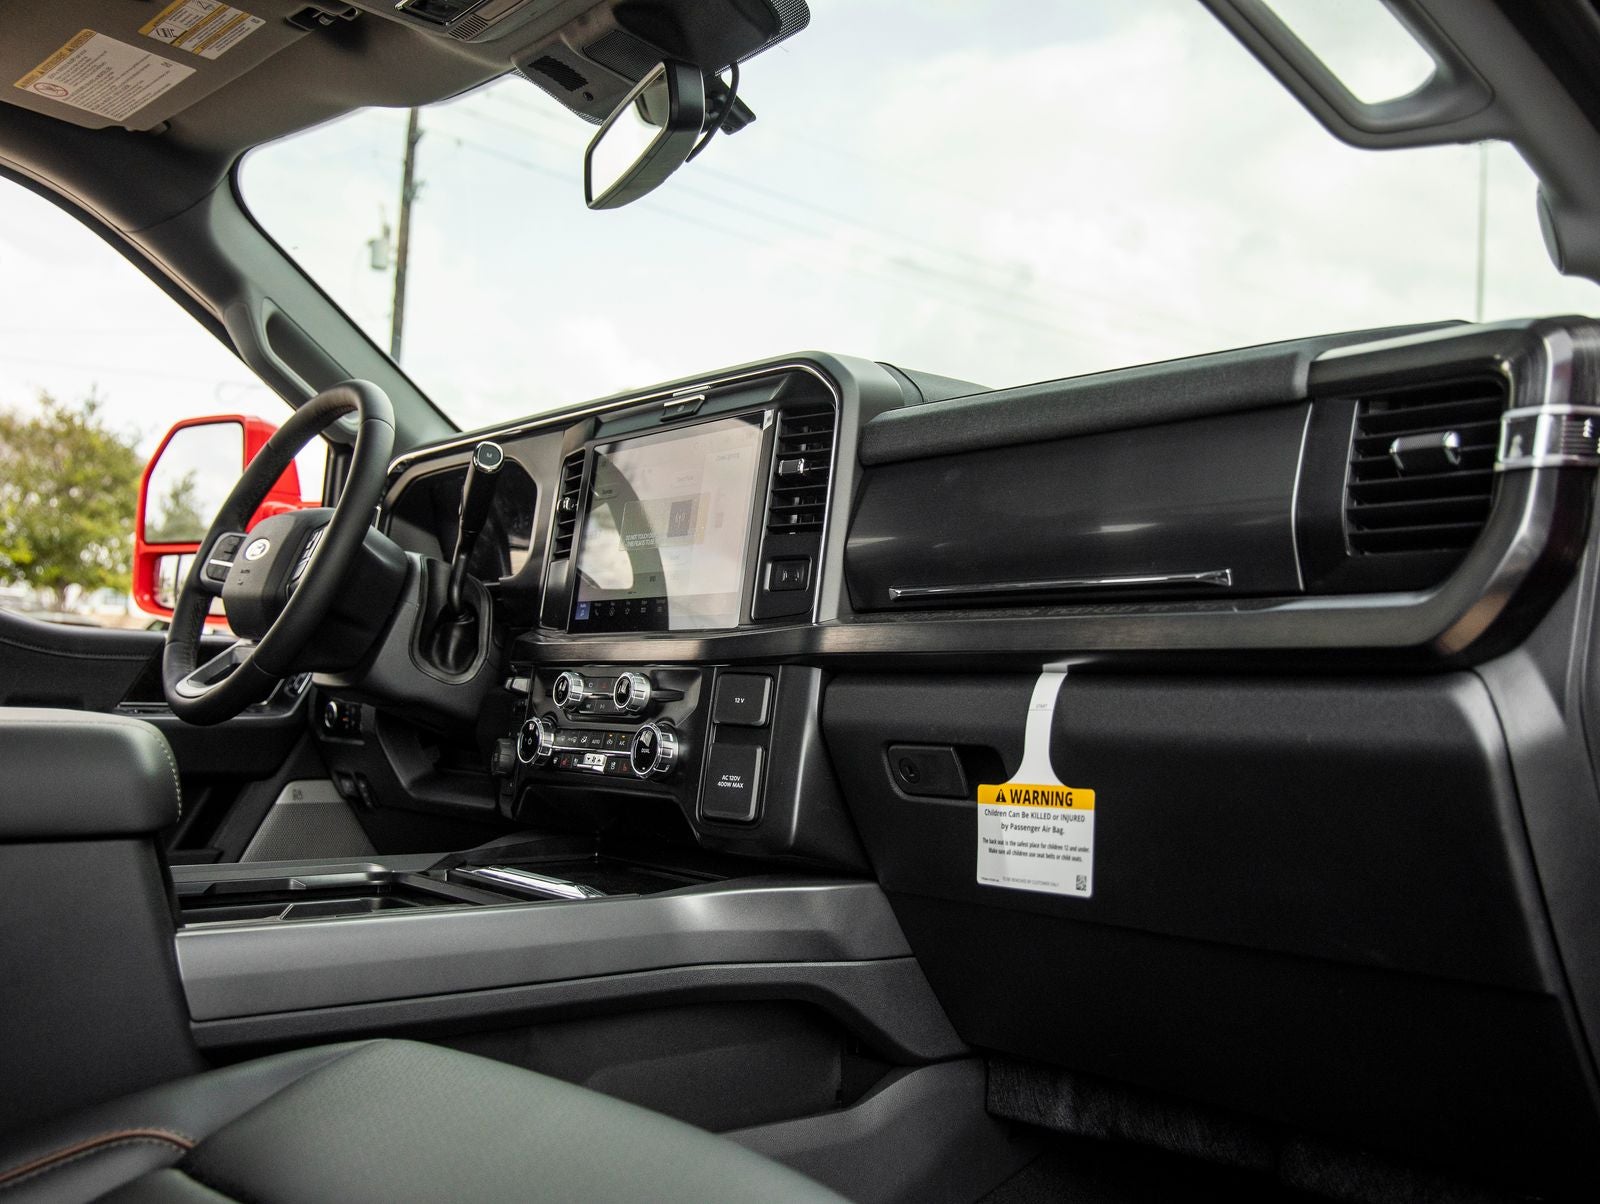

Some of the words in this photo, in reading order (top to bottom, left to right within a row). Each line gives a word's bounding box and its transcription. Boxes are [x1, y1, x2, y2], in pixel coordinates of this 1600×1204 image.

[1010, 789, 1073, 807] WARNING
[984, 809, 1007, 817] Children
[1008, 810, 1020, 818] Can
[1021, 811, 1029, 819] Be
[1030, 812, 1051, 820] KILLED
[1060, 813, 1086, 823] INJURED
[1000, 822, 1009, 831] by
[1010, 823, 1040, 833] Passenger
